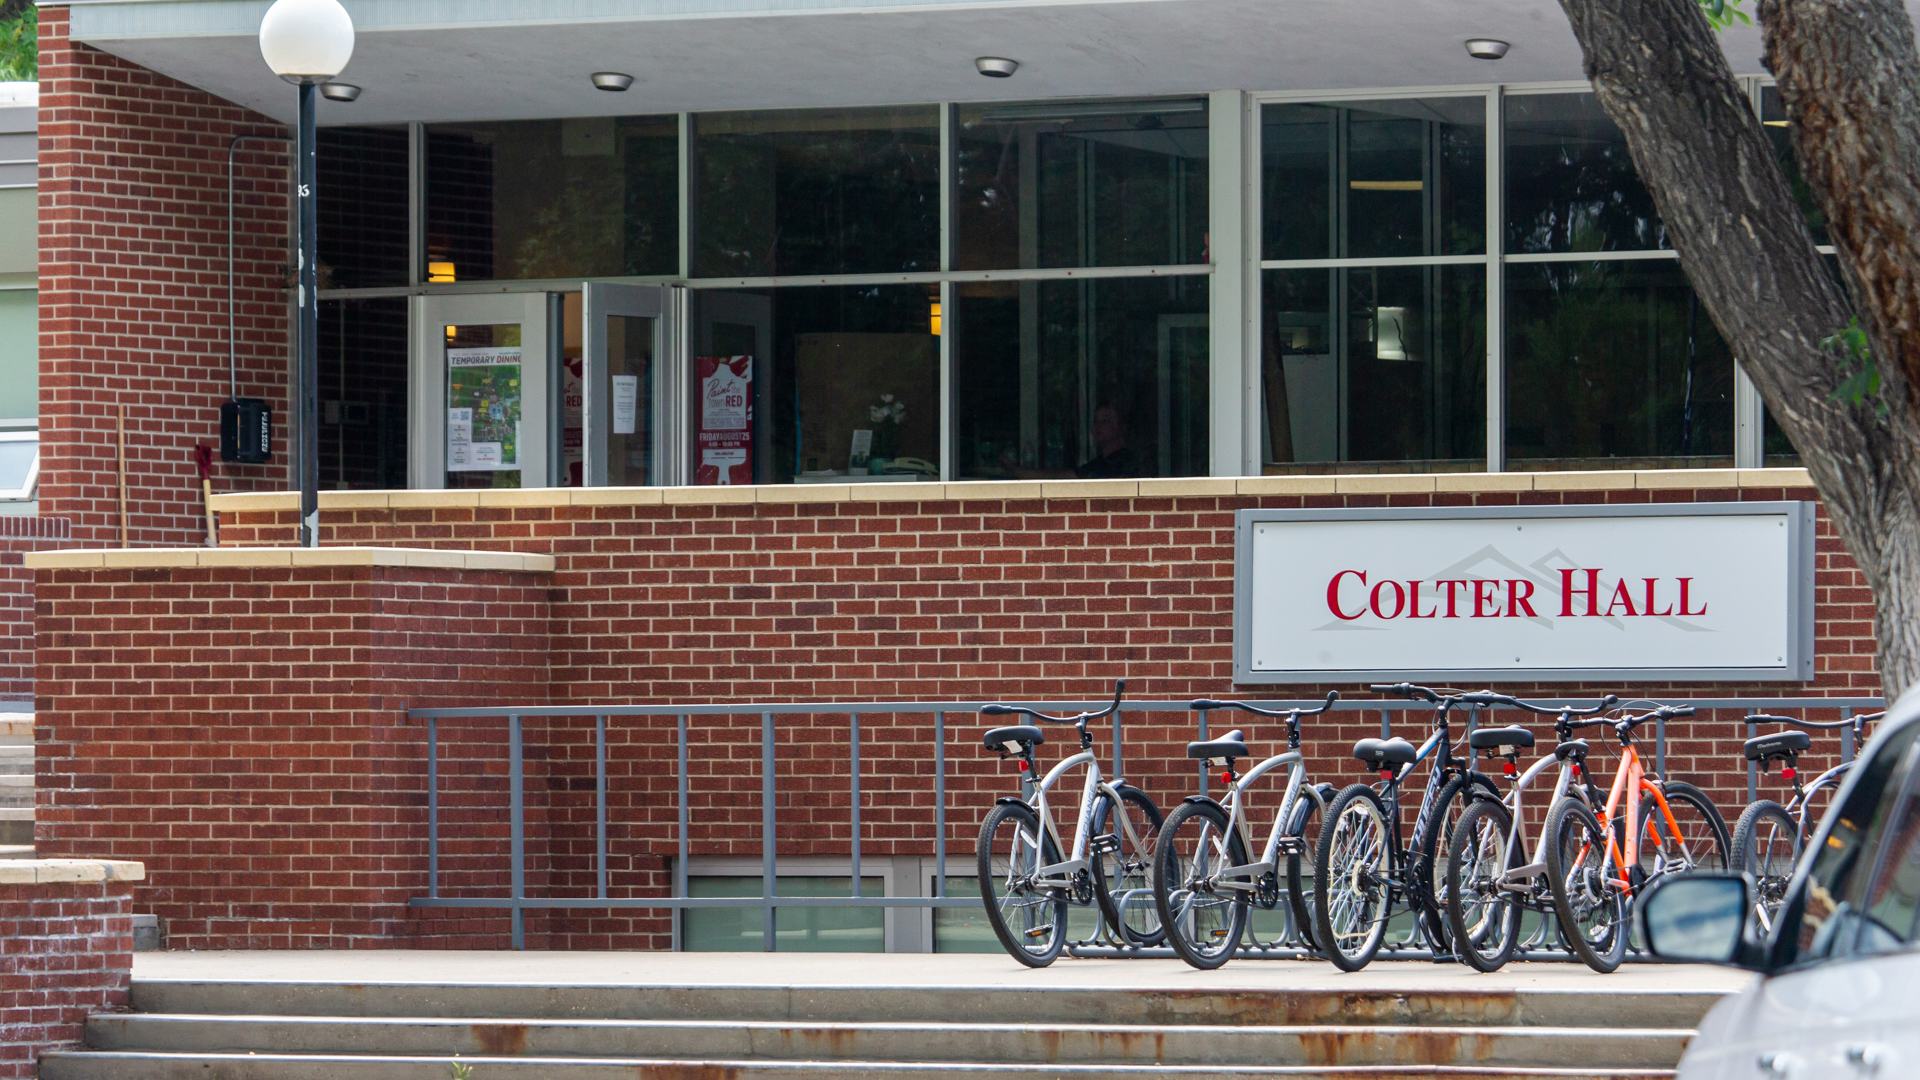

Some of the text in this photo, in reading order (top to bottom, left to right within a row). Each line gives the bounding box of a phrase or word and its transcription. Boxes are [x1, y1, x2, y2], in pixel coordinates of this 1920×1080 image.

[451, 355, 495, 365] TEMPORARY
[566, 395, 582, 407] RED
[707, 379, 735, 399] Paint
[725, 395, 743, 407] RED
[1326, 568, 1708, 621] COLTER HALL
[1078, 783, 1096, 857] SEACHANGE
[1269, 783, 1297, 858] SEACHANGE
[1414, 765, 1441, 847] HUFFY
